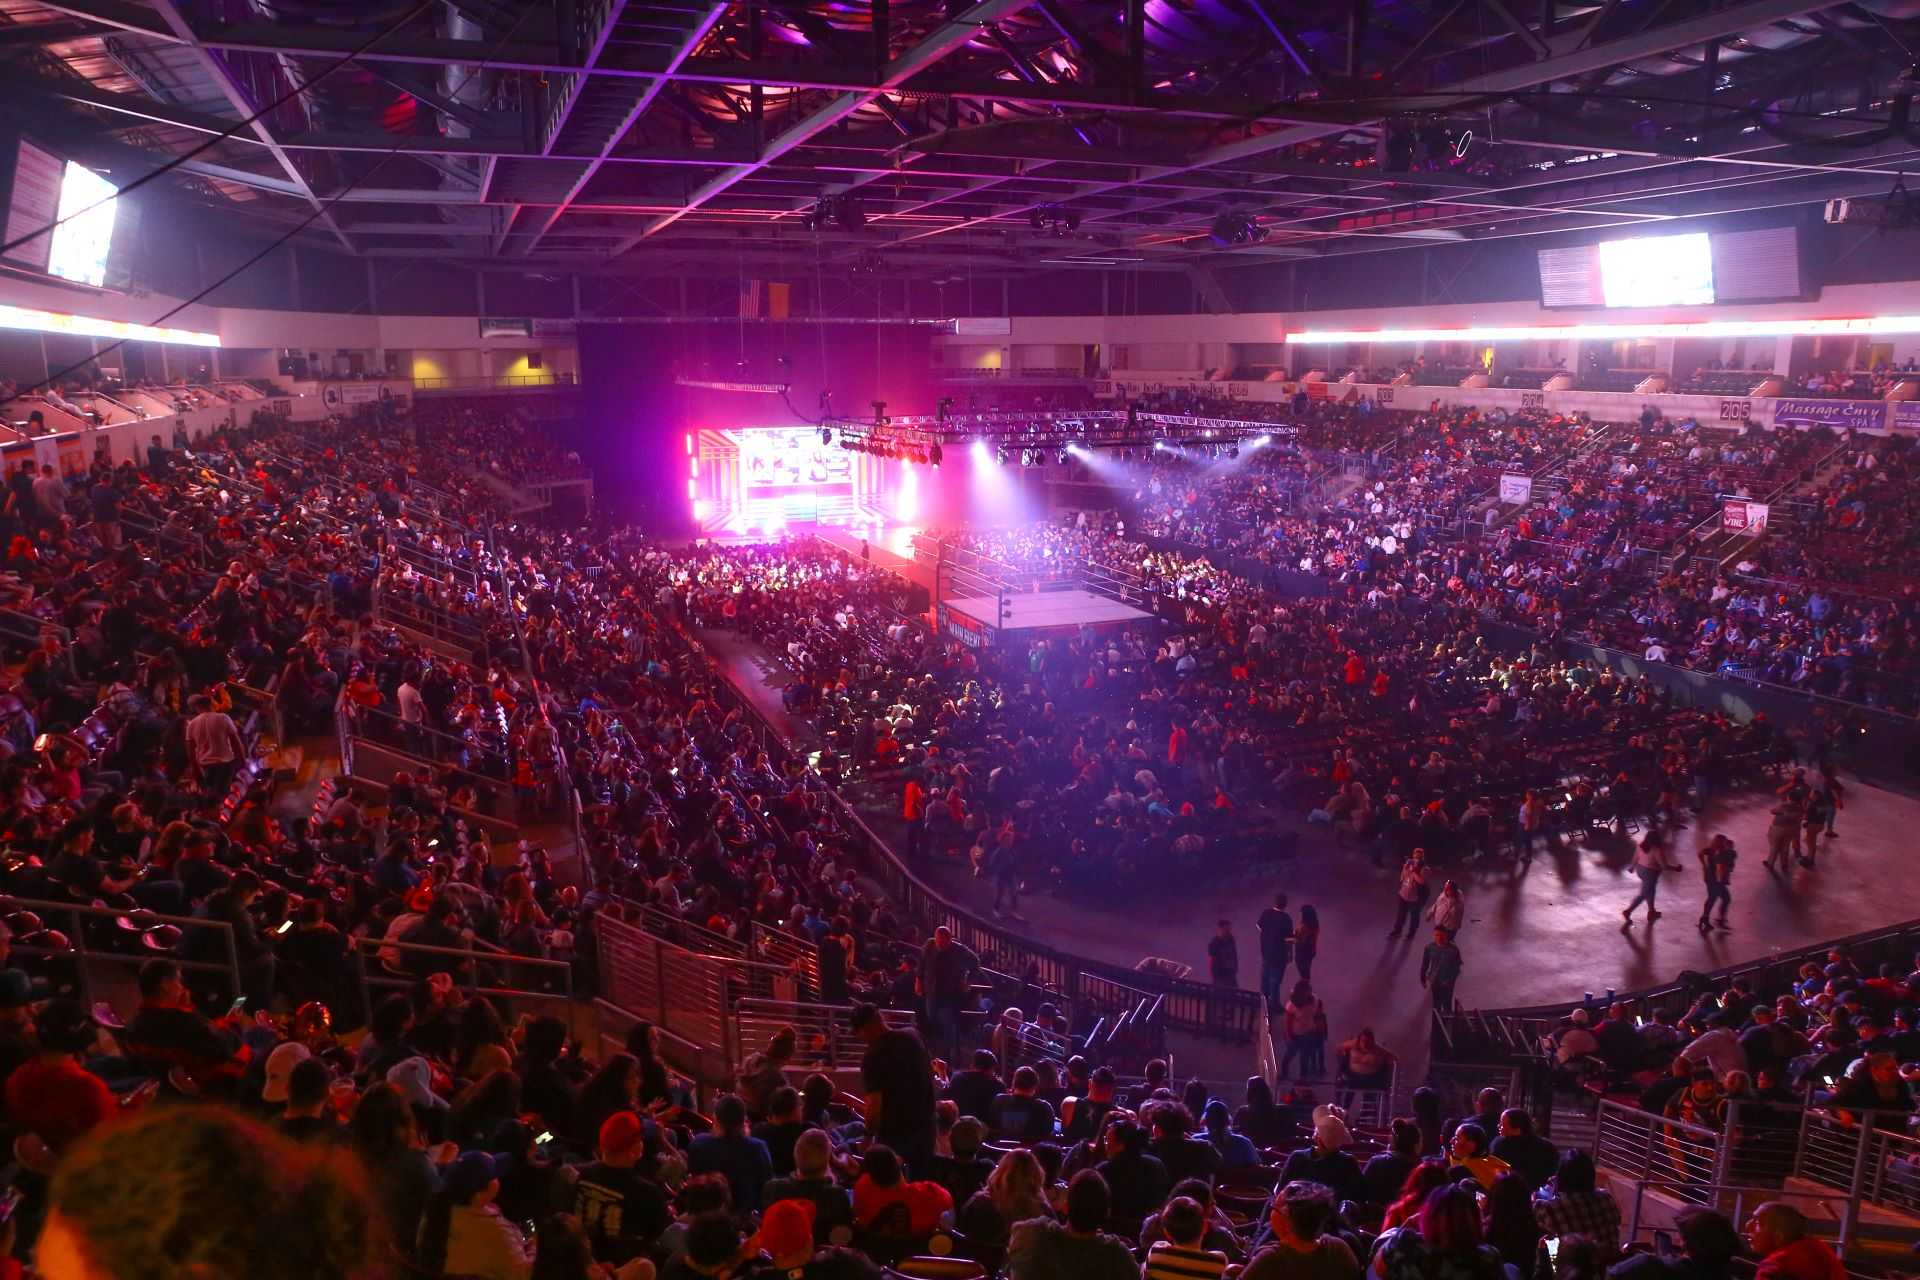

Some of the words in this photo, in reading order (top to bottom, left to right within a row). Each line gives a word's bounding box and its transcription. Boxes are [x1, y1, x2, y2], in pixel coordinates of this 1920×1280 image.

[1721, 402, 1750, 418] 205
[1776, 402, 1839, 419] Massage
[1850, 418, 1869, 427] SPA
[1723, 517, 1744, 528] WINE
